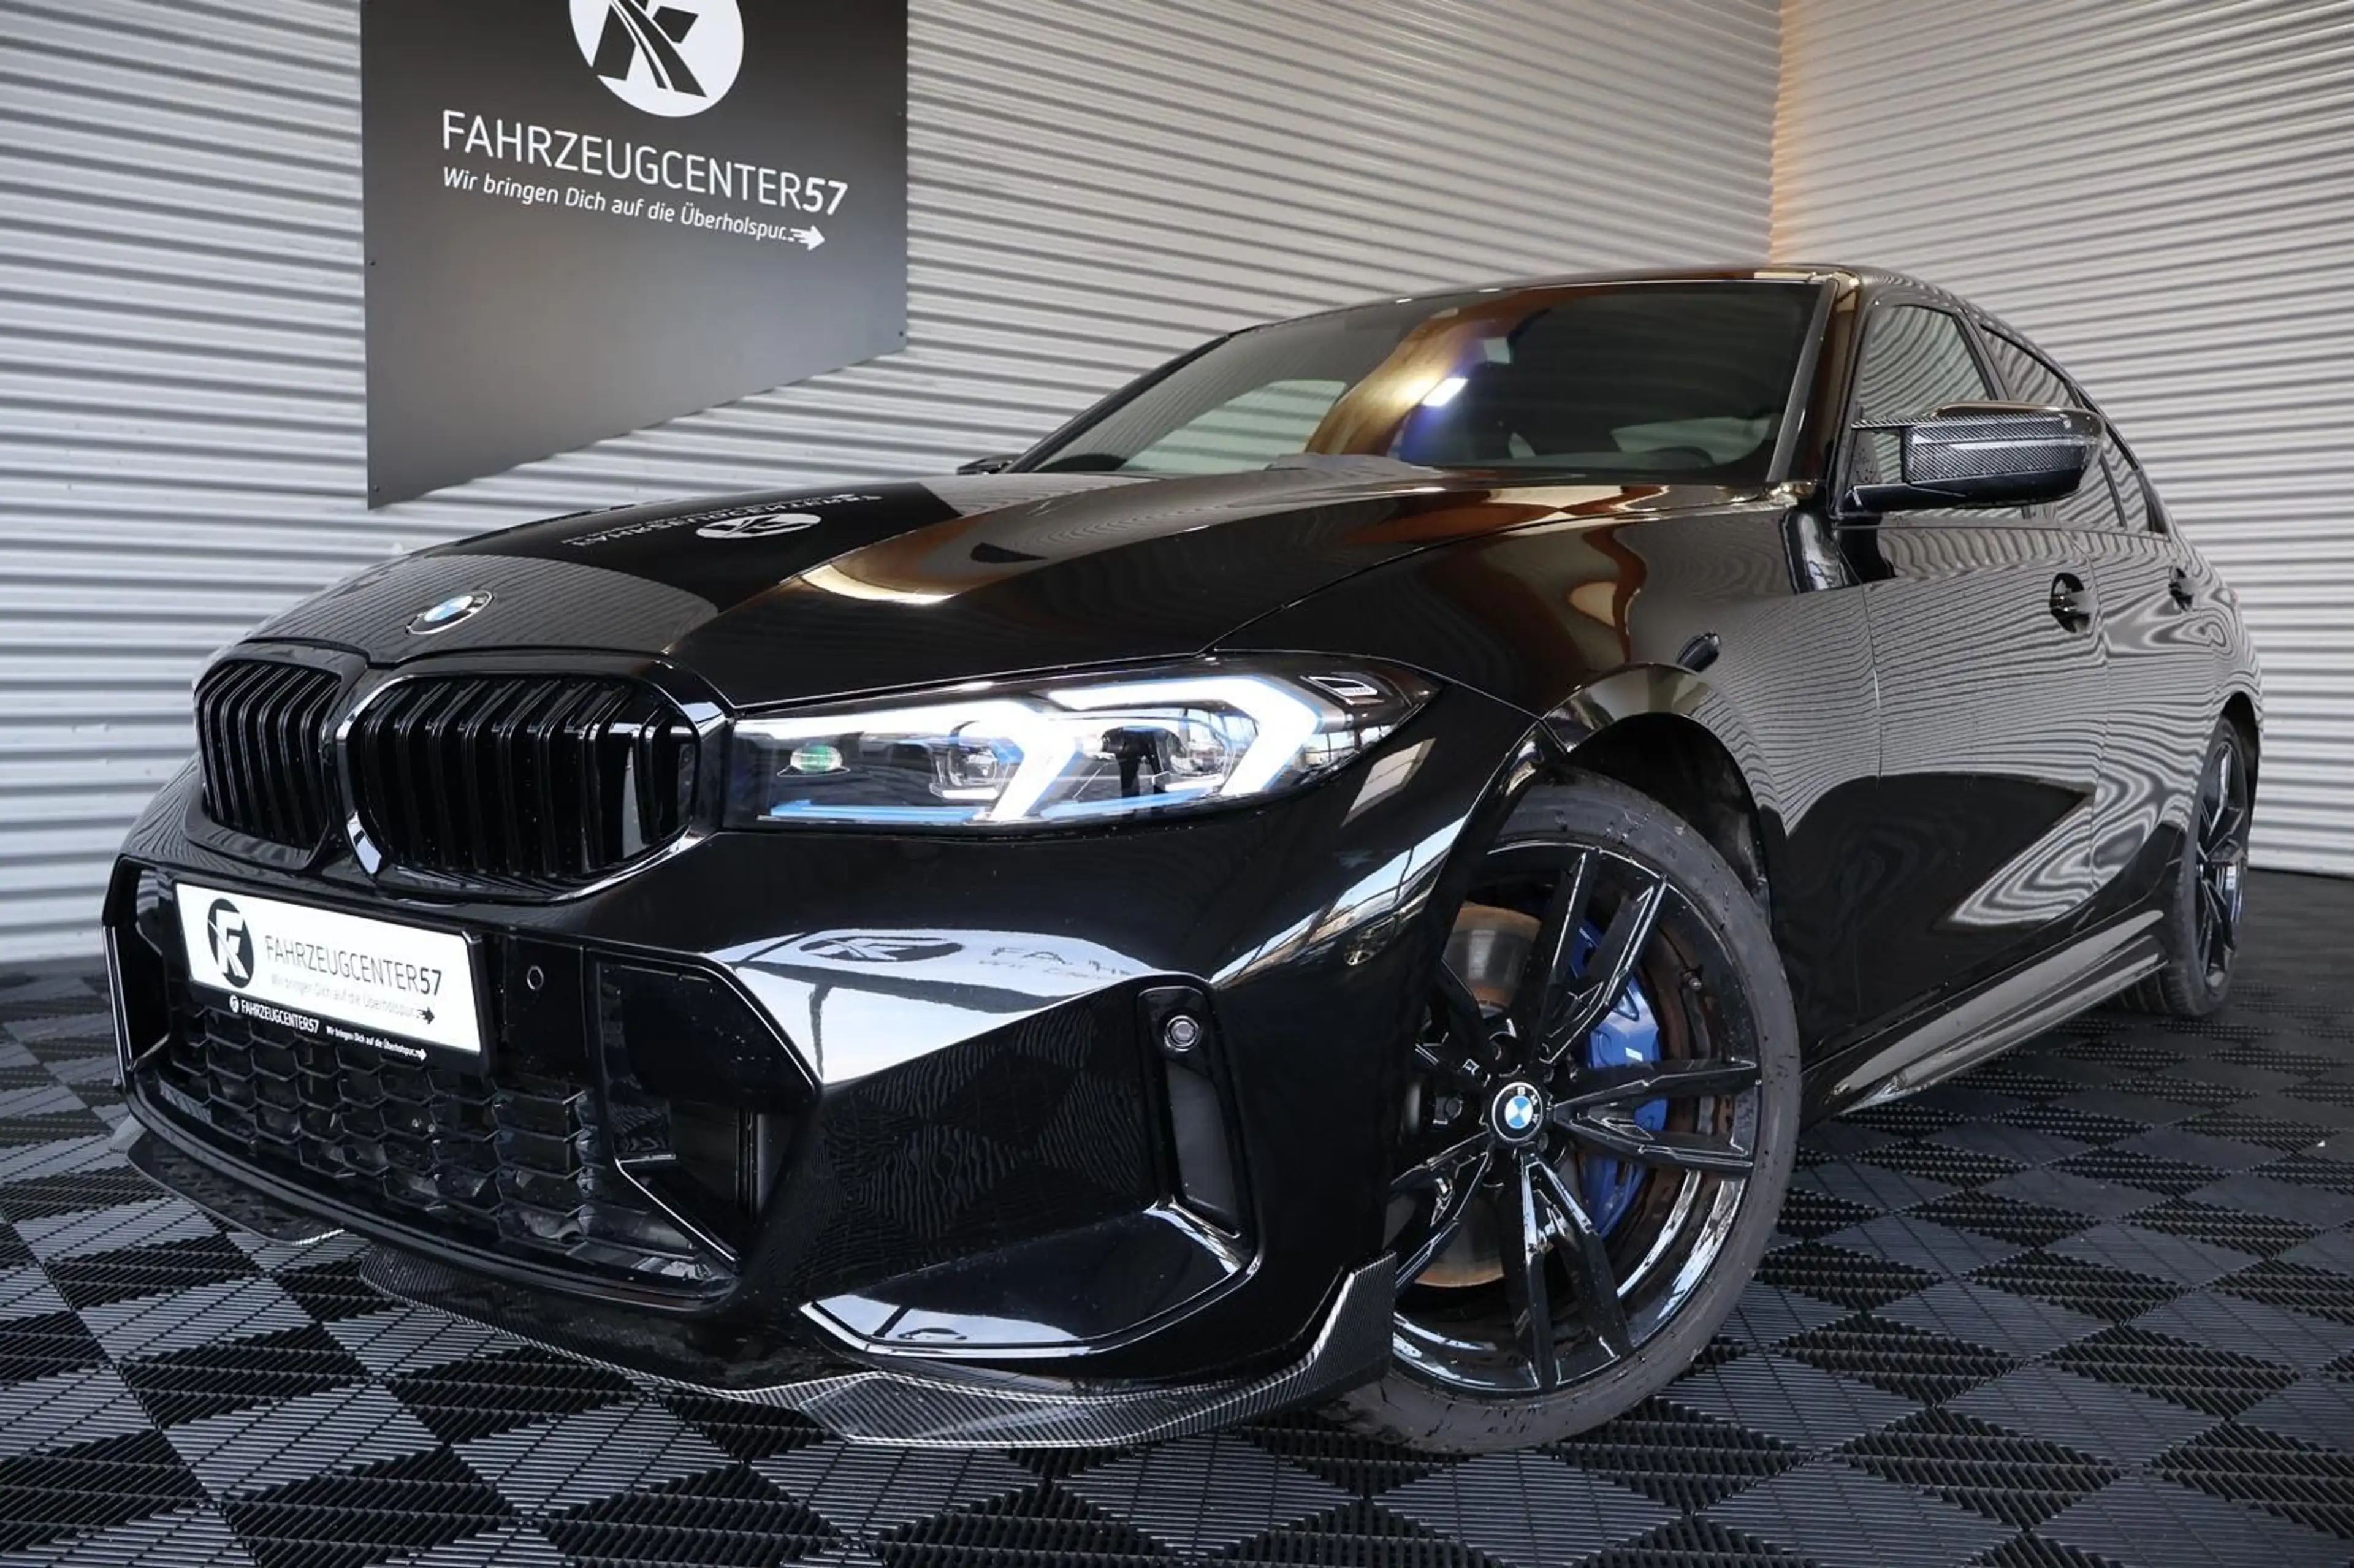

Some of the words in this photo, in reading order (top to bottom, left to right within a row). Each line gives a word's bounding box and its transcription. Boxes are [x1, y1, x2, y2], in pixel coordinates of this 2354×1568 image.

[443, 109, 848, 215] FAHRZEUGCENTER57
[443, 166, 478, 190] Wir
[483, 173, 558, 206] bringen
[565, 187, 606, 211] Dich
[611, 198, 645, 218] auf
[647, 201, 675, 223] die
[265, 935, 442, 996] FAHRZEUGCENTER57
